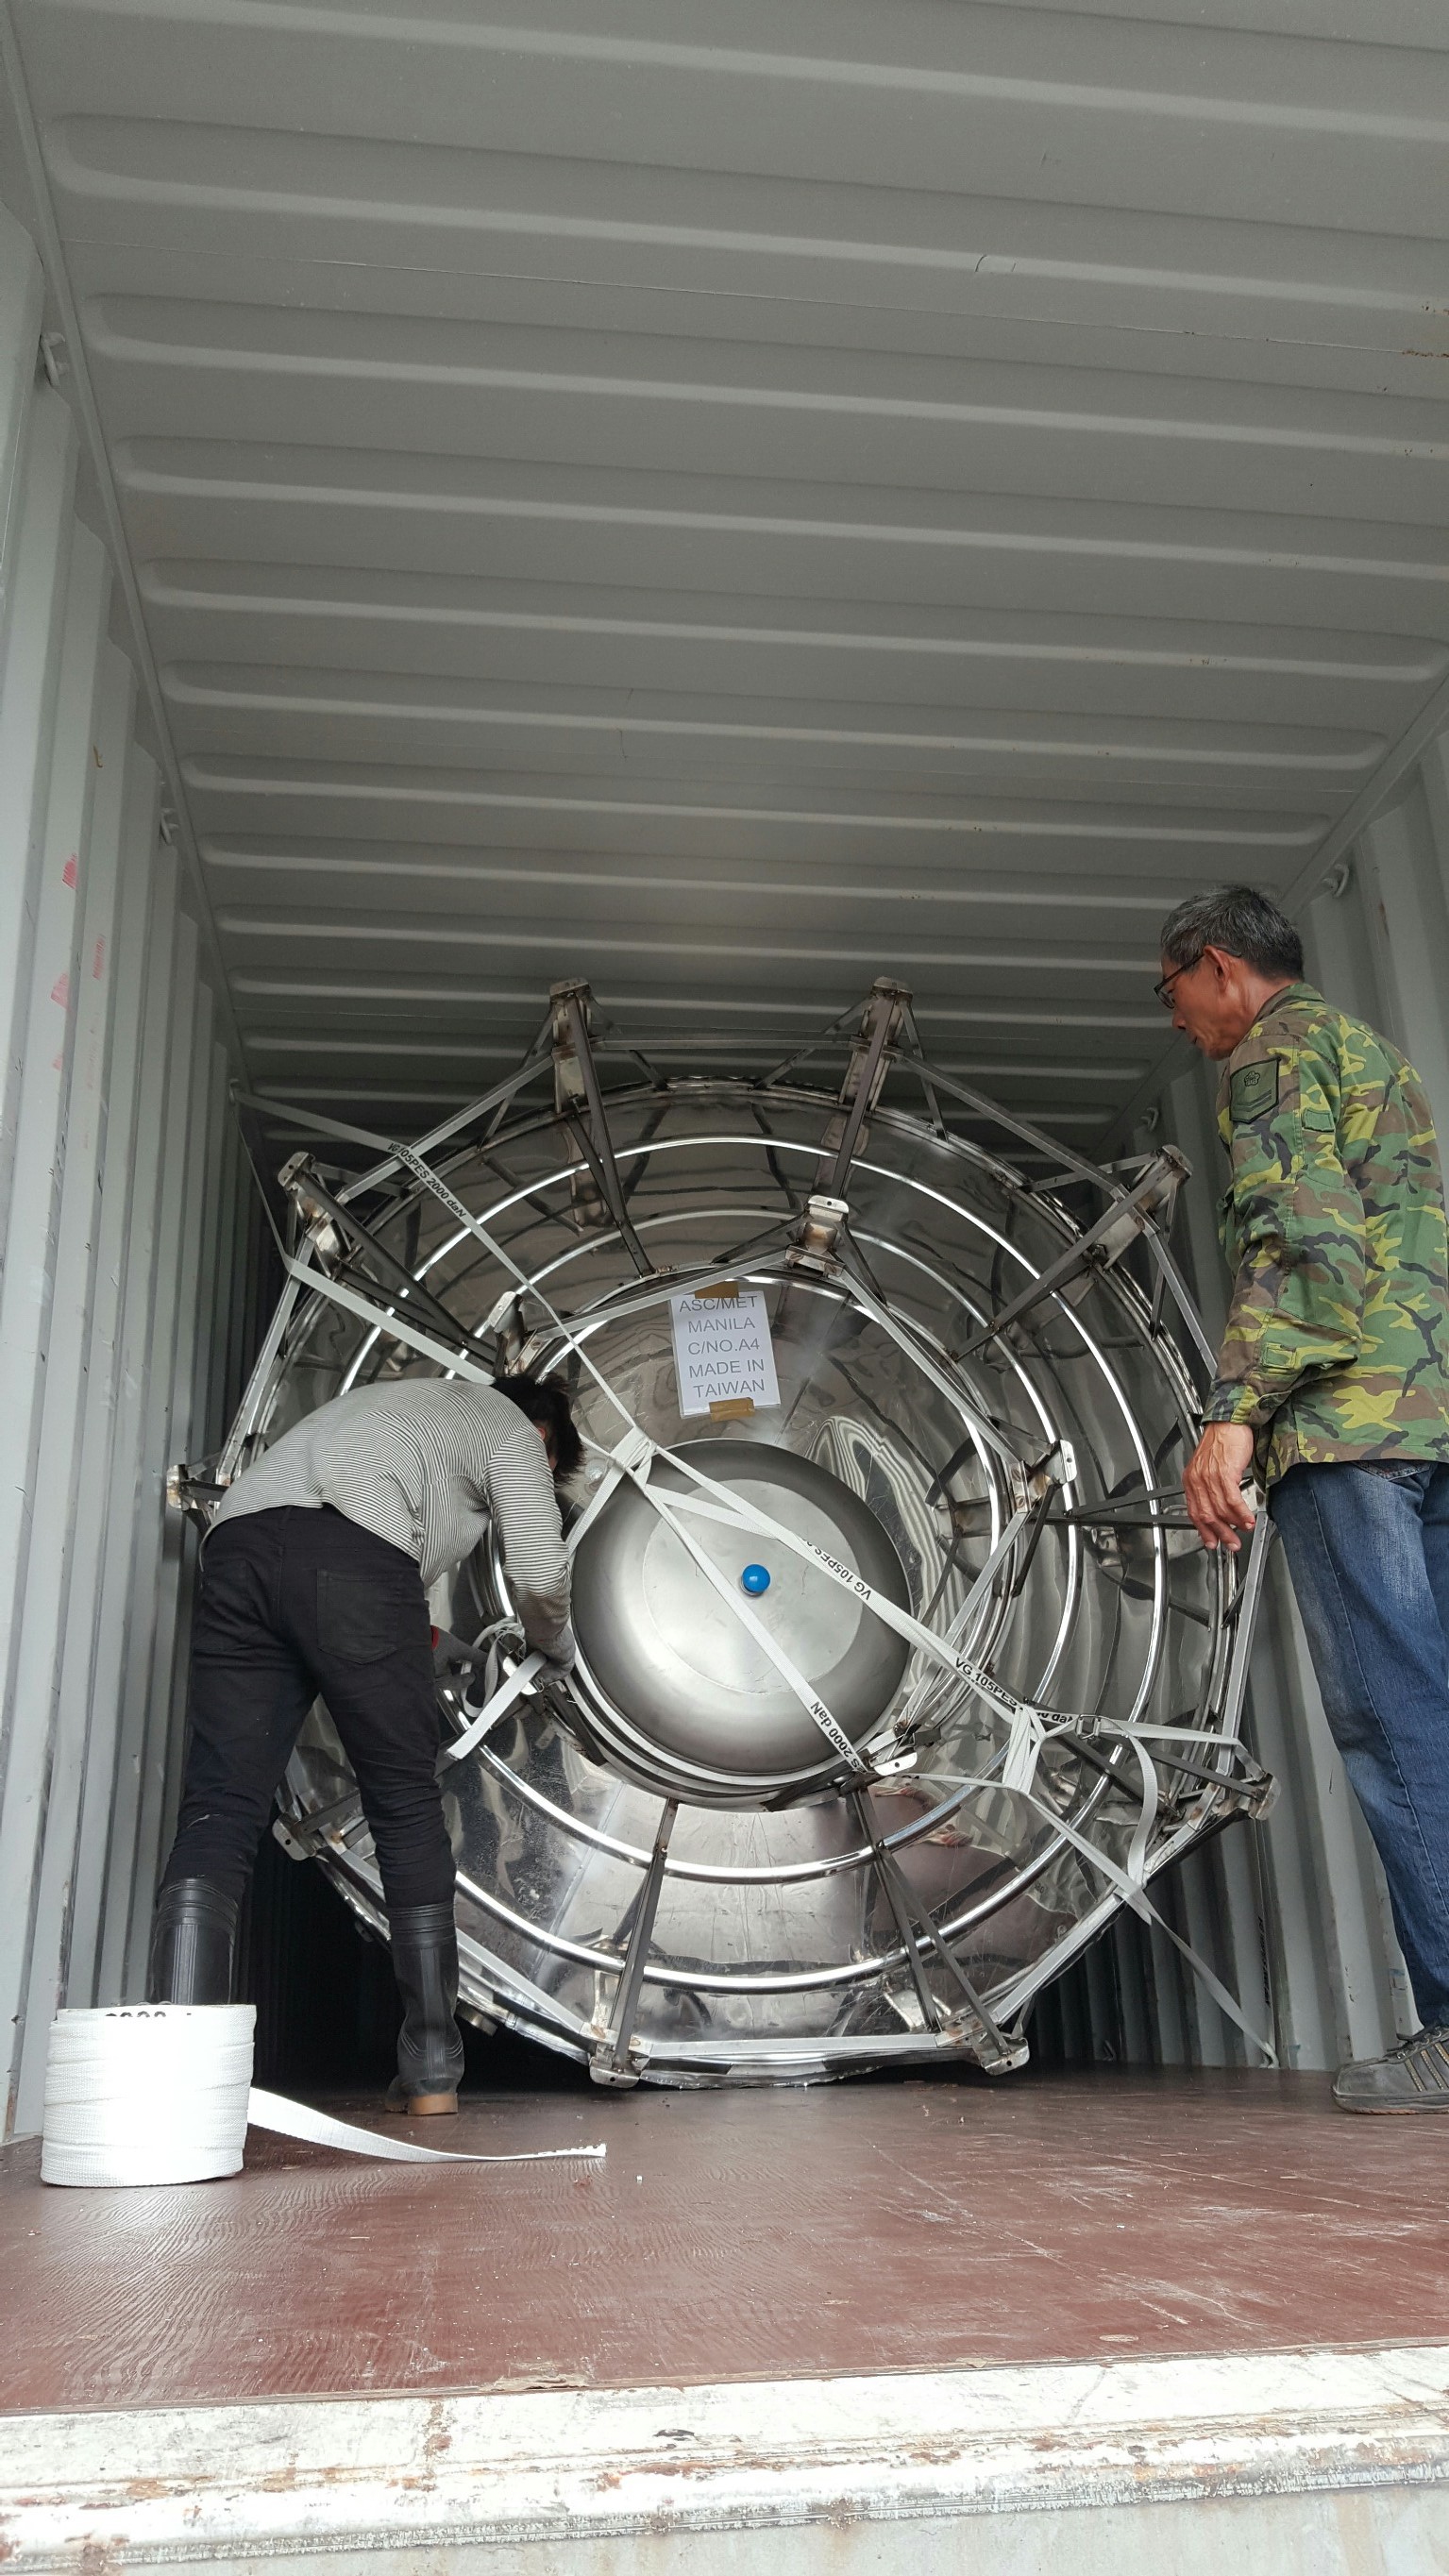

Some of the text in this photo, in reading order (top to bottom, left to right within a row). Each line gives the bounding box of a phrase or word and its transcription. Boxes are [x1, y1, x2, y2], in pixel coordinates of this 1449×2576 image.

[397, 1148, 430, 1179] 105PES
[426, 1178, 449, 1200] 2000
[446, 1200, 467, 1218] daN
[679, 1295, 758, 1312] ASC/MET
[688, 1317, 756, 1333] MANILA
[687, 1338, 760, 1355] C/NO.A4
[689, 1359, 765, 1378] MADE IN
[693, 1379, 765, 1398] TAIWAN
[853, 1582, 872, 1600] VG
[954, 1657, 973, 1675] VG
[810, 1701, 853, 1758] 2000 daN
